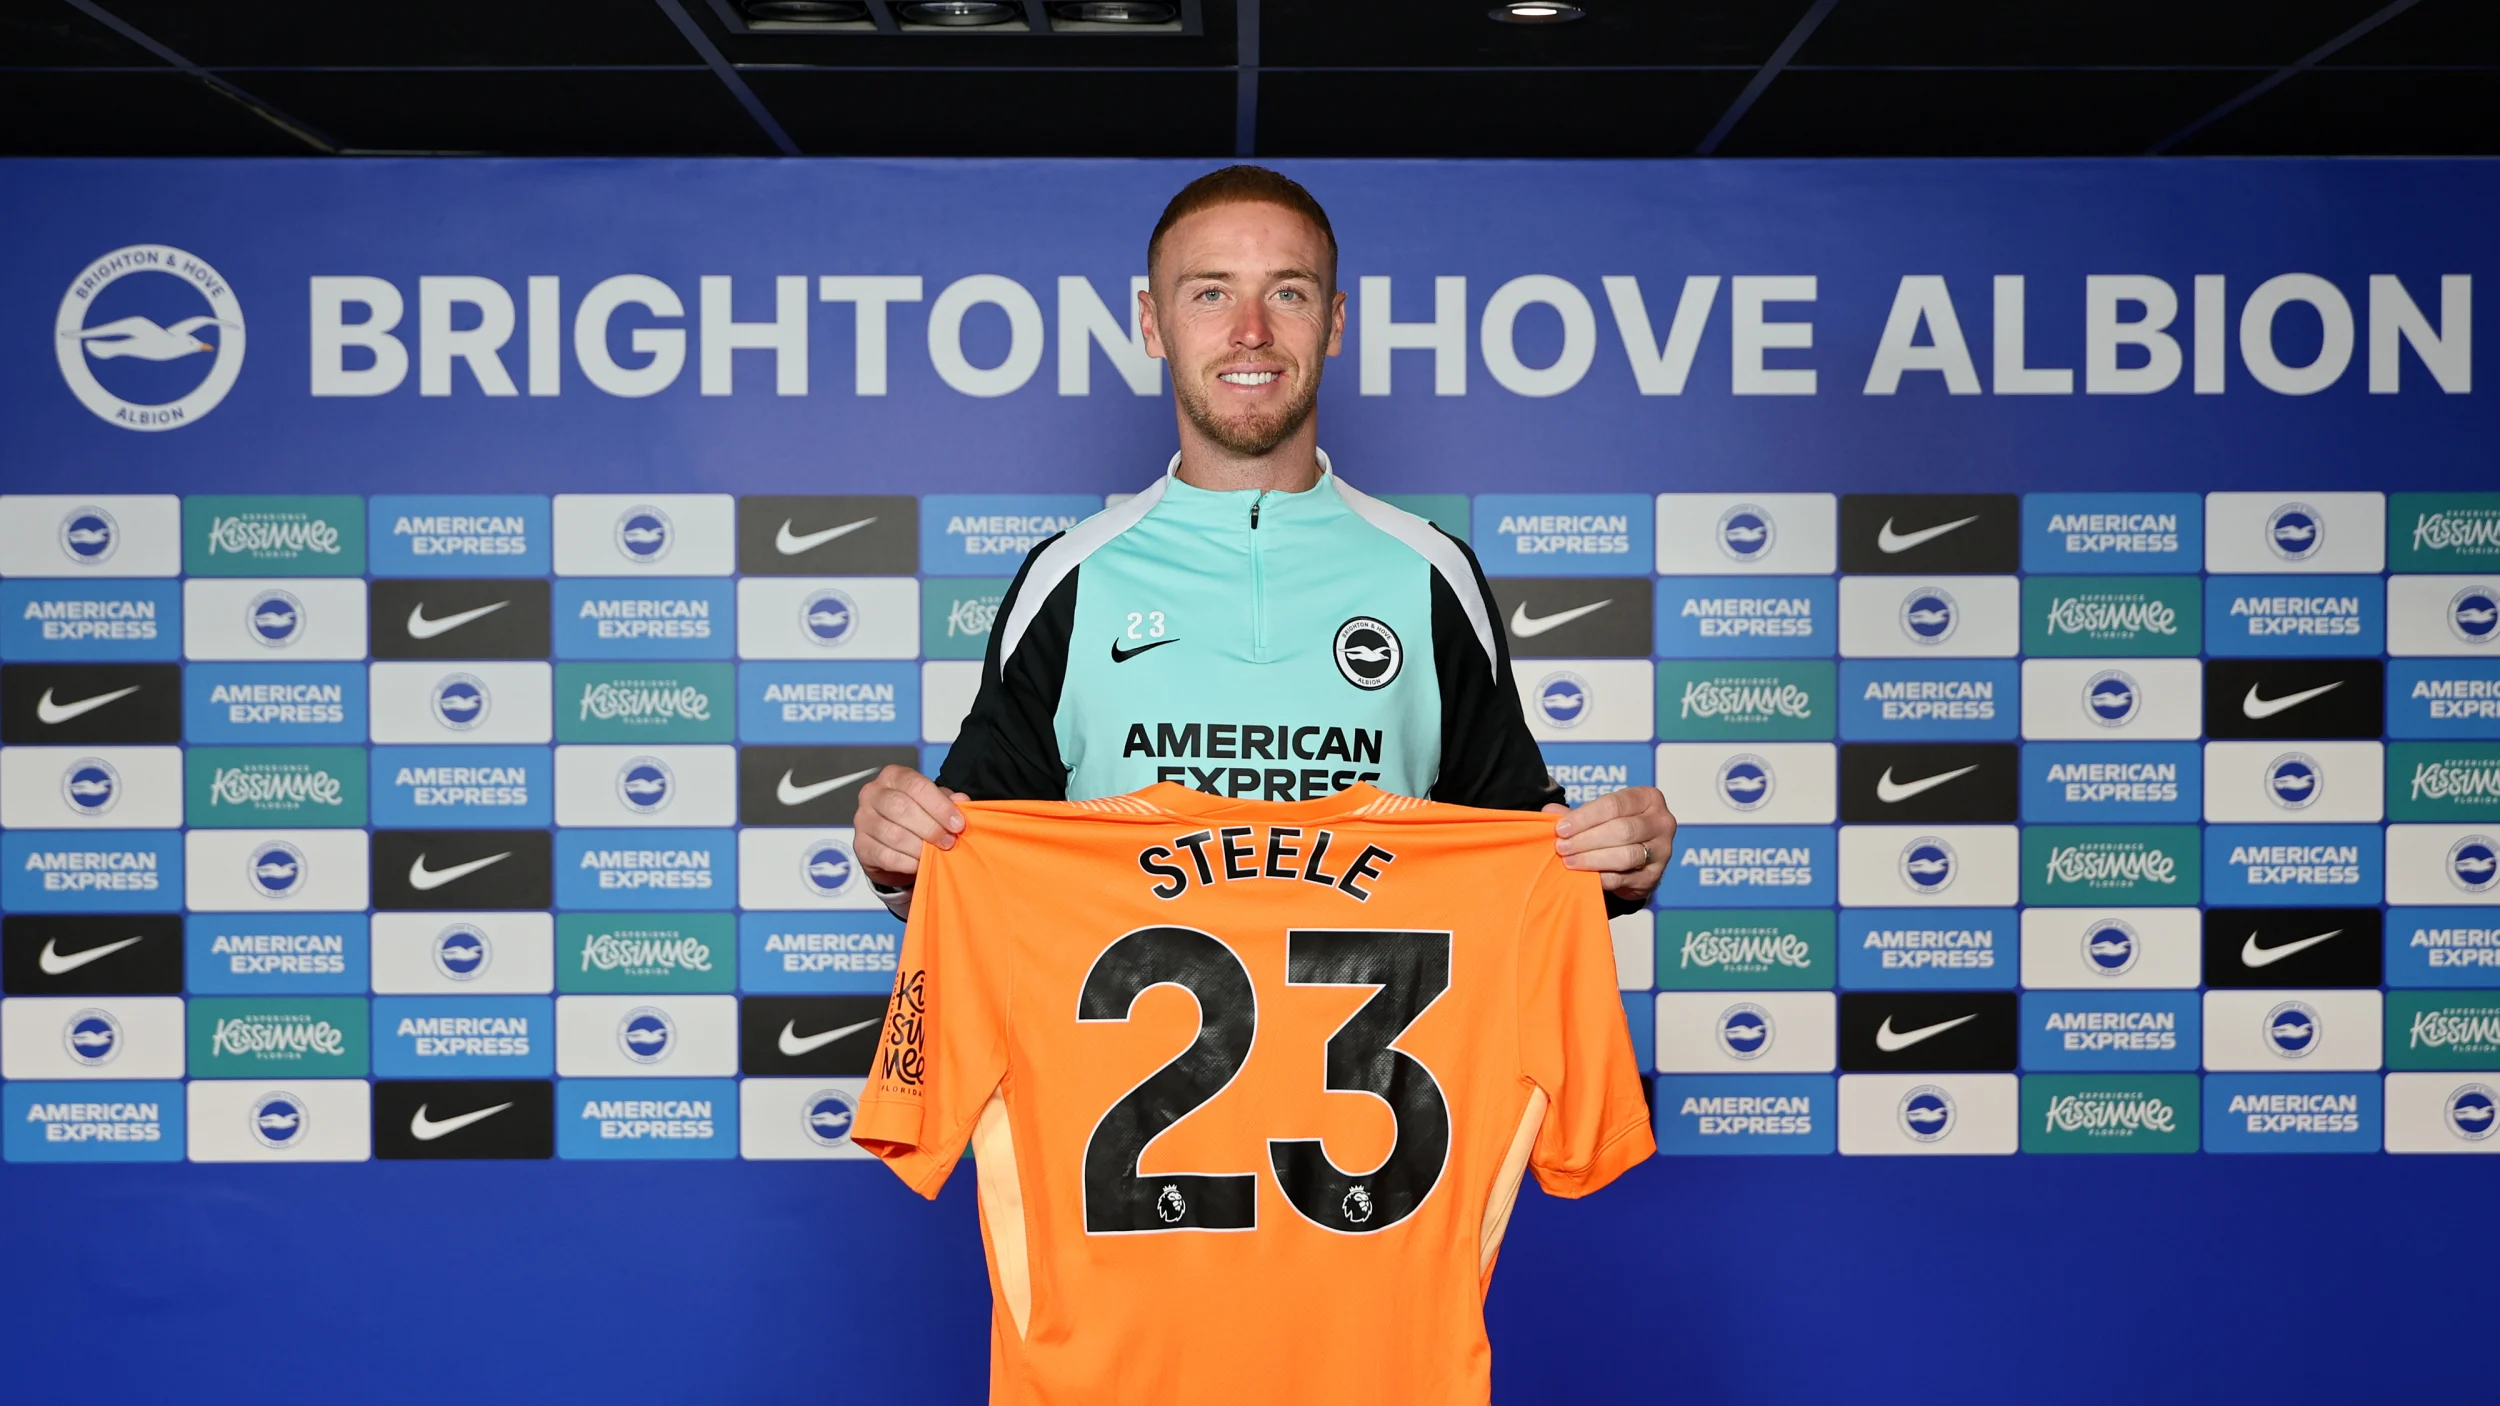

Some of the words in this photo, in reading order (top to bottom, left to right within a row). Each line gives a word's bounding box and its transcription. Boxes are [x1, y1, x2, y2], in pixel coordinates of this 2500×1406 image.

[75, 250, 159, 300] BRIGHTON
[166, 253, 176, 268] &
[183, 259, 226, 298] HOVE
[310, 273, 1163, 397] BRIGHTON
[1359, 274, 1818, 397] HOVE
[1862, 272, 2473, 395] ALBION
[115, 406, 185, 425] ALBION
[394, 517, 524, 535] AMERICAN
[1498, 516, 1627, 534] AMERICAN
[2048, 515, 2176, 532] AMERICAN
[2412, 514, 2500, 552] Kissim
[413, 536, 526, 554] EXPRESS
[966, 535, 1046, 554] EXPR
[1517, 535, 1629, 554] EXPRESS
[2066, 534, 2178, 552] EXPRESS
[24, 601, 155, 620] AMERICAN
[580, 600, 708, 618] AMERICAN
[1681, 599, 1810, 617] AMERICAN
[2230, 598, 2358, 615] AMERICAN
[43, 621, 157, 639] EXPRESS
[598, 620, 711, 638] EXPRESS
[1127, 611, 1165, 639] 23
[1341, 621, 1369, 639] BRIGHTON
[1376, 625, 1393, 641] HOVE
[1700, 618, 1812, 636] EXPRESS
[2249, 617, 2360, 635] EXPRESS
[1357, 677, 1381, 685] ALBION
[2412, 681, 2500, 698] AMERIC
[211, 685, 341, 703] AMERICAN
[764, 684, 893, 702] AMERICAN
[1864, 682, 1992, 700] AMERICAN
[230, 704, 343, 723] EXPRESS
[783, 703, 896, 721] EXPRESS
[1883, 701, 1994, 719] EXPRESS
[2430, 700, 2500, 718] EXPR
[1122, 723, 1383, 764] AMERICAN
[395, 768, 525, 786] AMERICAN
[1546, 765, 1627, 783] RICAN
[2047, 764, 2175, 782] AMERICAN
[2411, 763, 2500, 801] Kissim
[414, 787, 527, 805] EXPRESS
[2066, 783, 2178, 801] EXPRESS
[26, 852, 156, 871] AMERICAN
[581, 851, 710, 869] AMERICAN
[1138, 826, 1397, 903] STEELE
[1681, 848, 1810, 866] AMERICAN
[2229, 847, 2357, 864] AMERICAN
[44, 872, 158, 890] EXPRESS
[600, 870, 712, 888] EXPRESS
[1700, 867, 1812, 885] EXPRESS
[2248, 866, 2359, 884] EXPRESS
[212, 936, 342, 954] AMERICAN
[765, 934, 894, 952] AMERICAN
[1864, 931, 1992, 948] AMERICAN
[2410, 929, 2500, 947] AMERIC
[231, 955, 345, 973] EXPRESS
[783, 953, 897, 972] EXPRESS
[1882, 950, 1994, 968] EXPRESS
[2429, 949, 2500, 966] EXPR
[397, 1018, 527, 1036] AMERICAN
[2045, 1013, 2174, 1030] AMERICAN
[2409, 1011, 2500, 1049] Kissim
[416, 1037, 530, 1056] EXPRESS
[2064, 1032, 2176, 1050] EXPRESS
[1076, 924, 1453, 1236] 23
[27, 1103, 158, 1122] AMERICAN
[582, 1101, 711, 1119] AMERICAN
[1681, 1097, 1809, 1115] AMERICAN
[2229, 1095, 2357, 1113] AMERICAN
[46, 1123, 161, 1141] EXPRESS
[601, 1120, 714, 1138] EXPRESS
[1700, 1116, 1811, 1134] EXPRESS
[2247, 1114, 2358, 1132] EXPRESS
